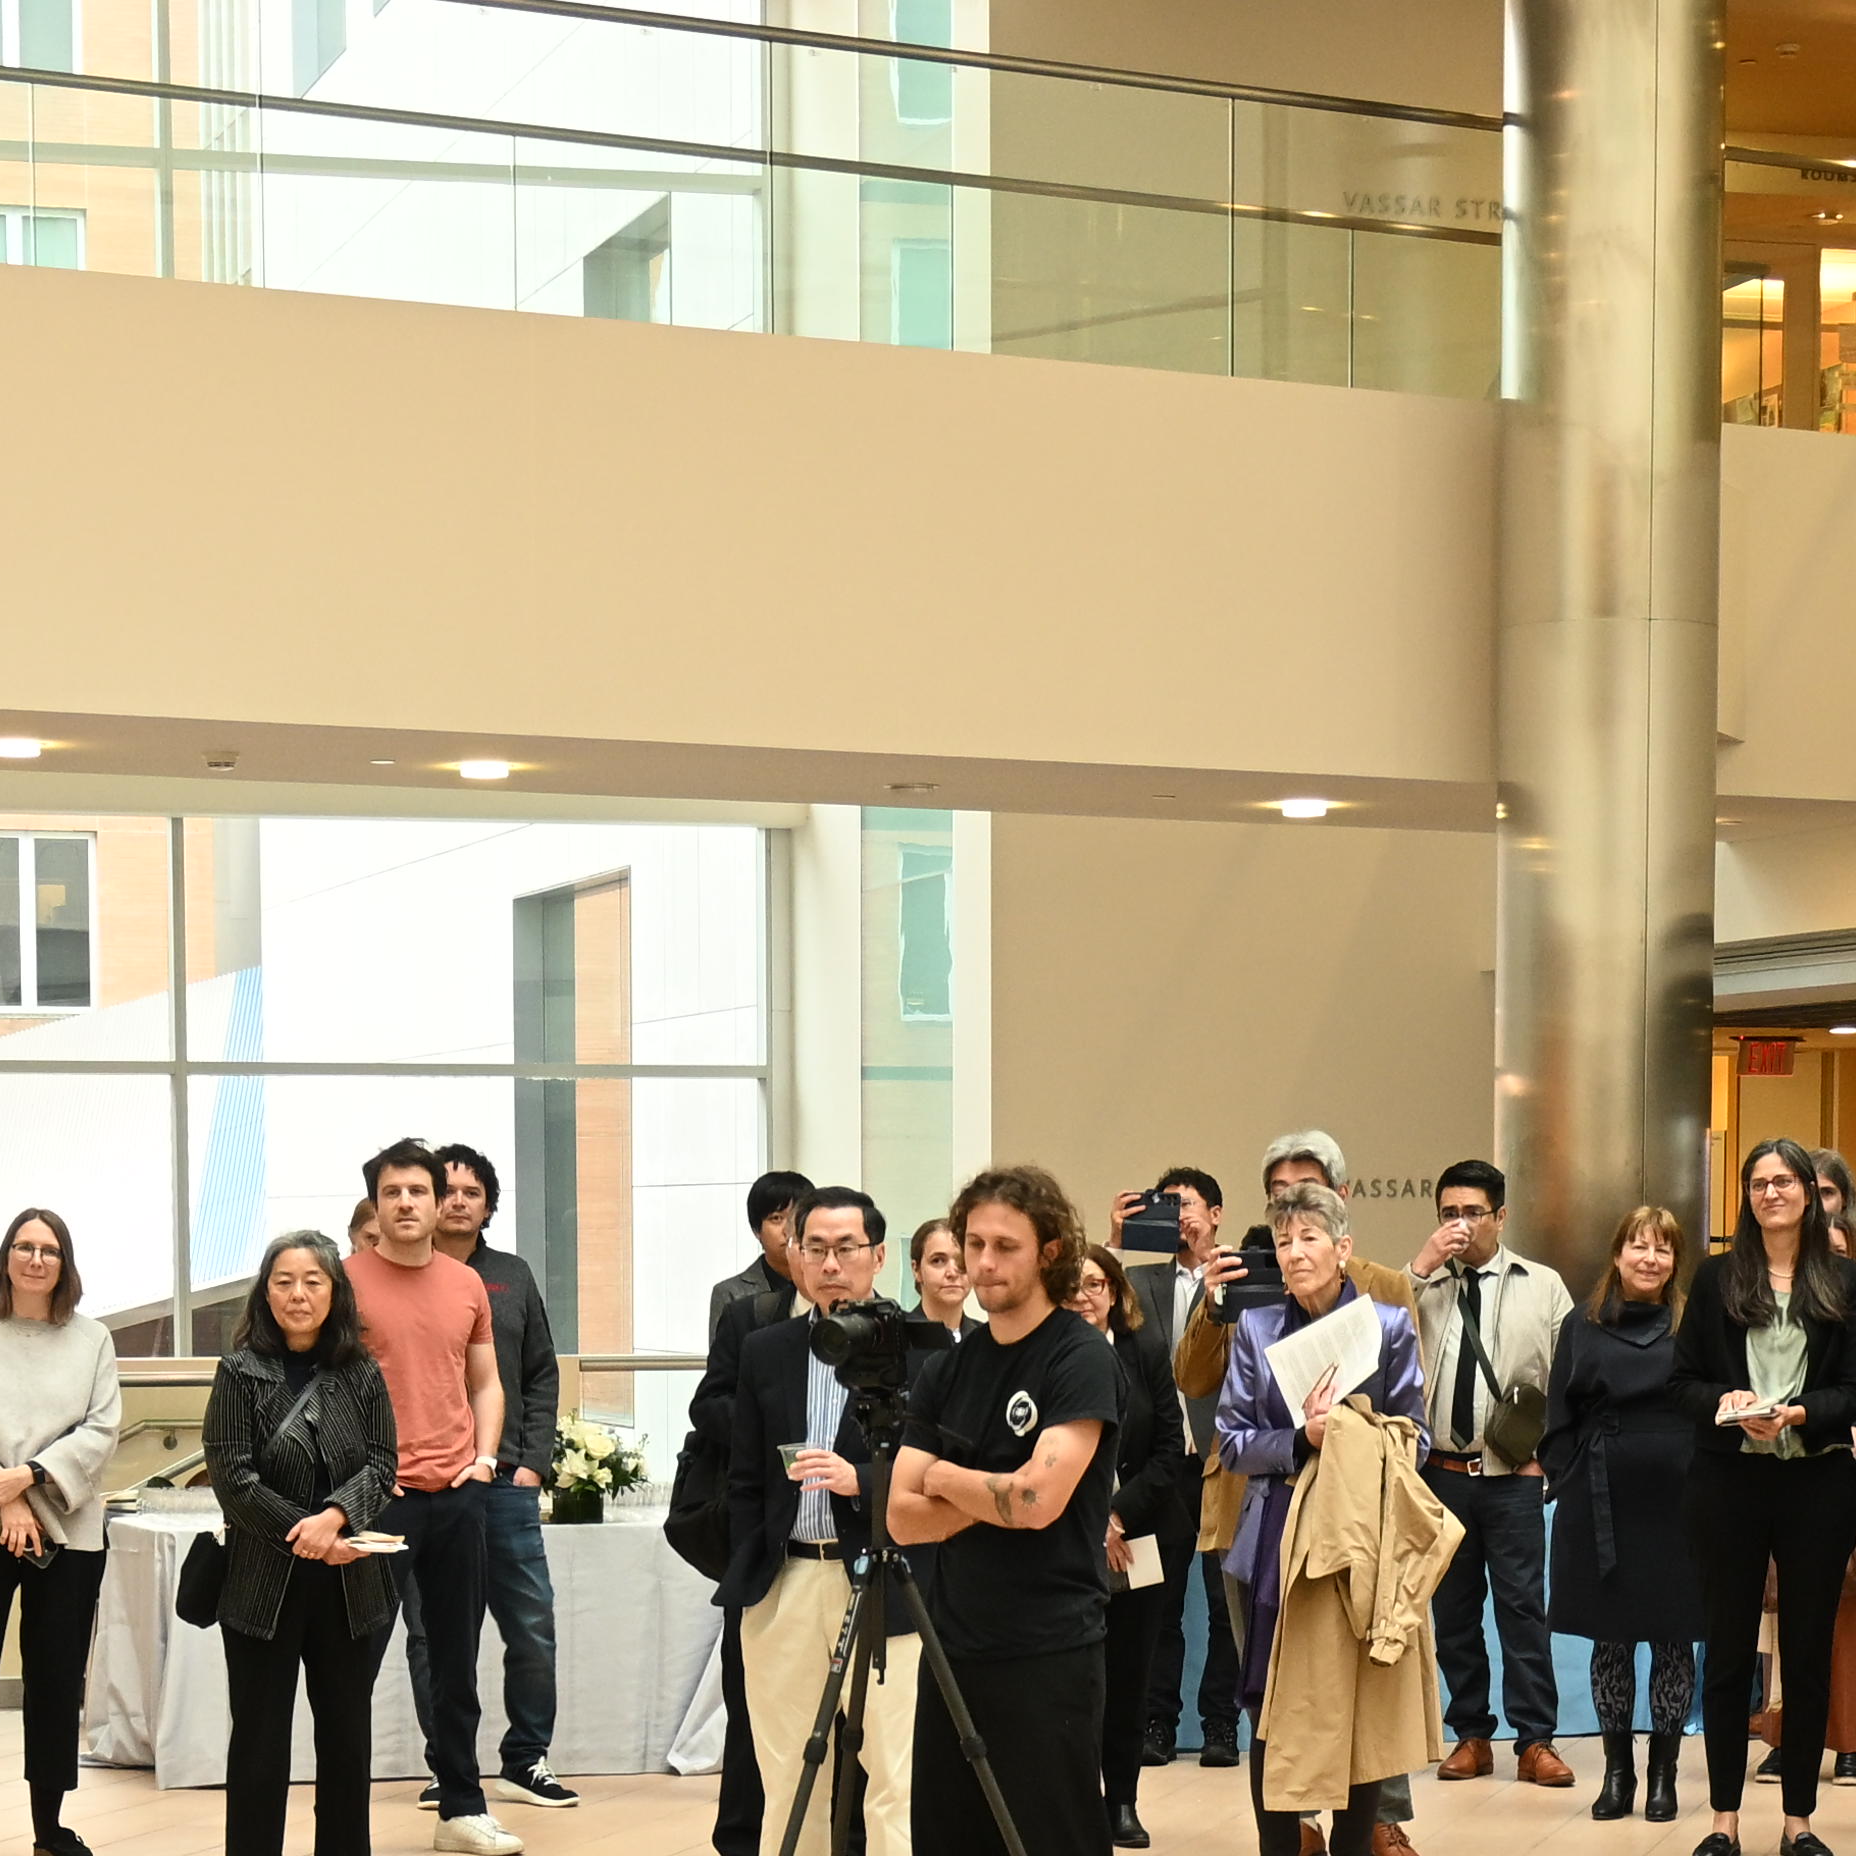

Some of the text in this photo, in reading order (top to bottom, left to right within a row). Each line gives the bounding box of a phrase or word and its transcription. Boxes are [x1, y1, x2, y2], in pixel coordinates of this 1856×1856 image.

[1343, 191, 1441, 218] VASSAR
[1748, 1041, 1787, 1073] EXIT
[1347, 1178, 1433, 1198] ASSAR
